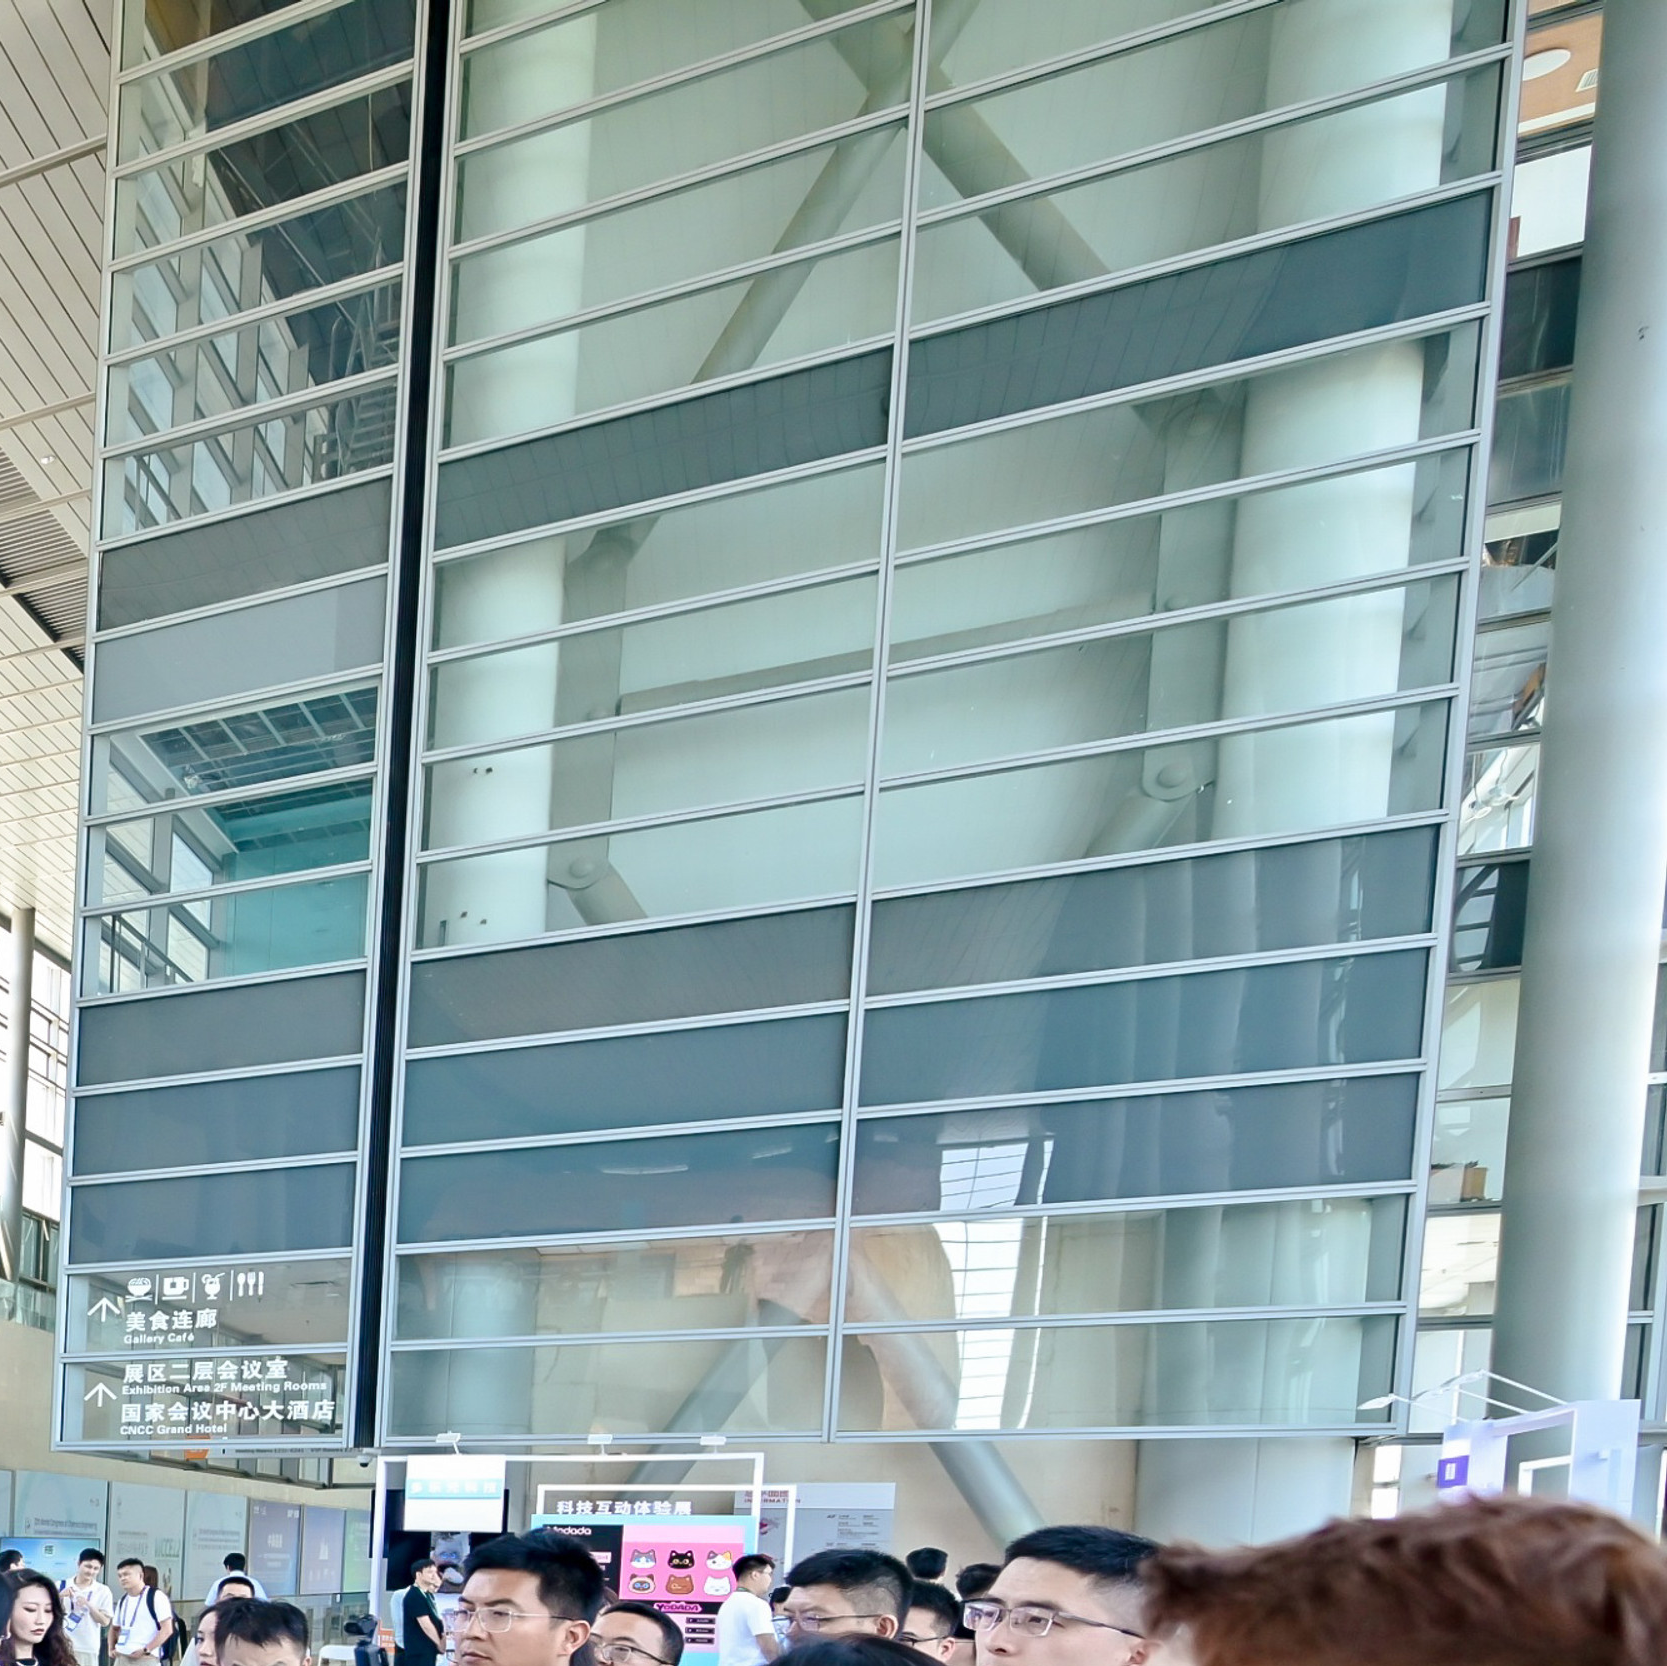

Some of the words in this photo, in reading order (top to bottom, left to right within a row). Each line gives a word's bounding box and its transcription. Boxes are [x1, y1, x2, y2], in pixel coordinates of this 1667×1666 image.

[126, 1308, 218, 1332] 美食连廊
[124, 1333, 165, 1345] Gallery
[123, 1355, 288, 1384] 展区二层会议室
[122, 1384, 180, 1396] Exhibition
[184, 1383, 210, 1394] Area
[214, 1382, 228, 1393] 2F
[231, 1381, 281, 1394] Meeting
[284, 1380, 328, 1391] Rooms
[121, 1400, 336, 1423] 国家会议中心大酒店
[120, 1425, 154, 1435] CNCC
[157, 1424, 193, 1434] Grand
[196, 1423, 228, 1434] Hotel
[556, 1500, 693, 1516] 科技互动体验展
